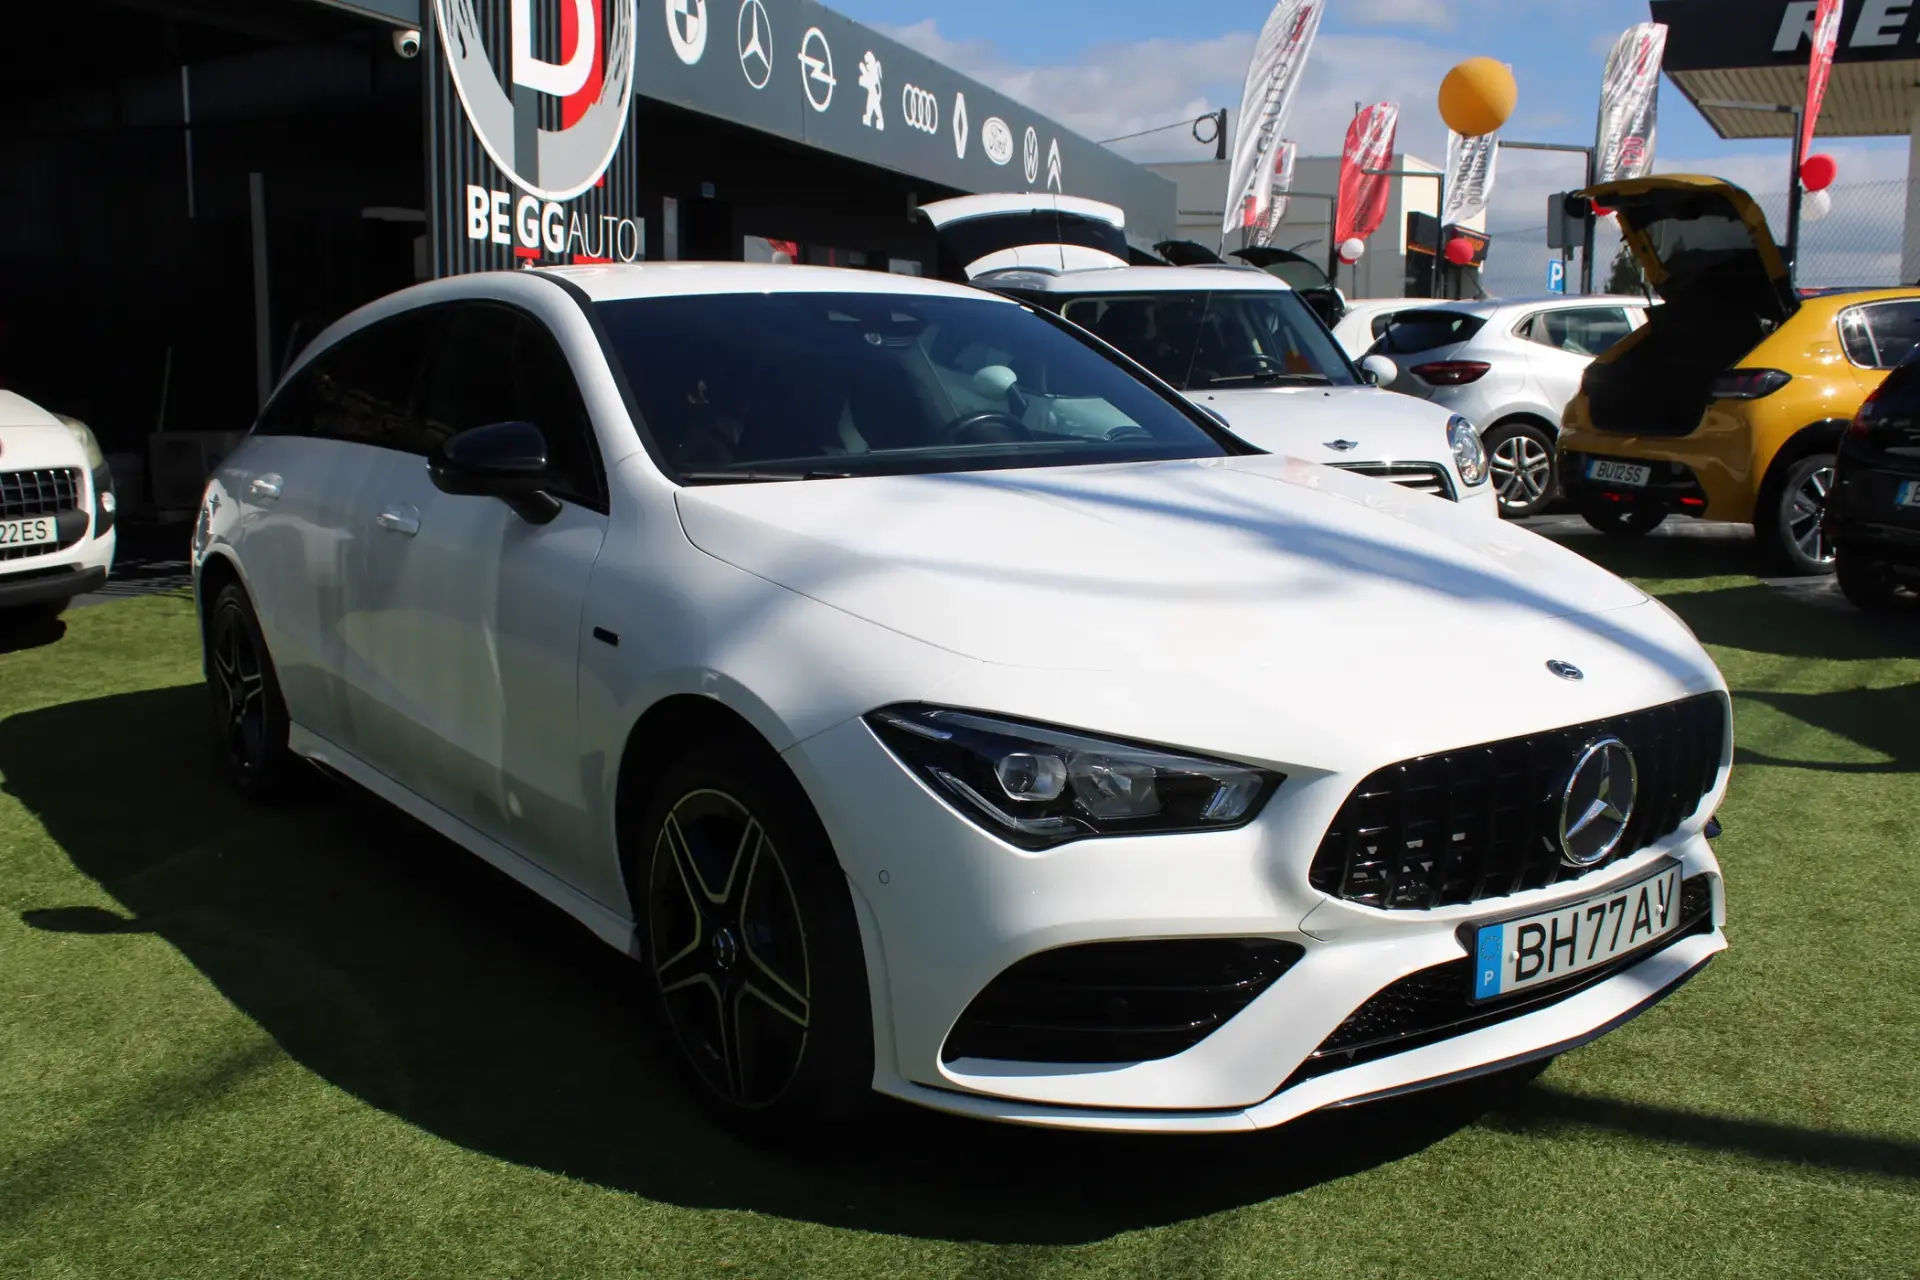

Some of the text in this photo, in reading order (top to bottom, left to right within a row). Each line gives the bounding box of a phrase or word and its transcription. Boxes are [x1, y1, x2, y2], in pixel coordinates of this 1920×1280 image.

[1772, 0, 1920, 51] RE
[1550, 262, 1564, 289] P
[1596, 461, 1643, 483] BU12SS
[0, 520, 47, 545] 22ES
[1514, 872, 1675, 983] BH77AV
[1484, 970, 1495, 987] P
